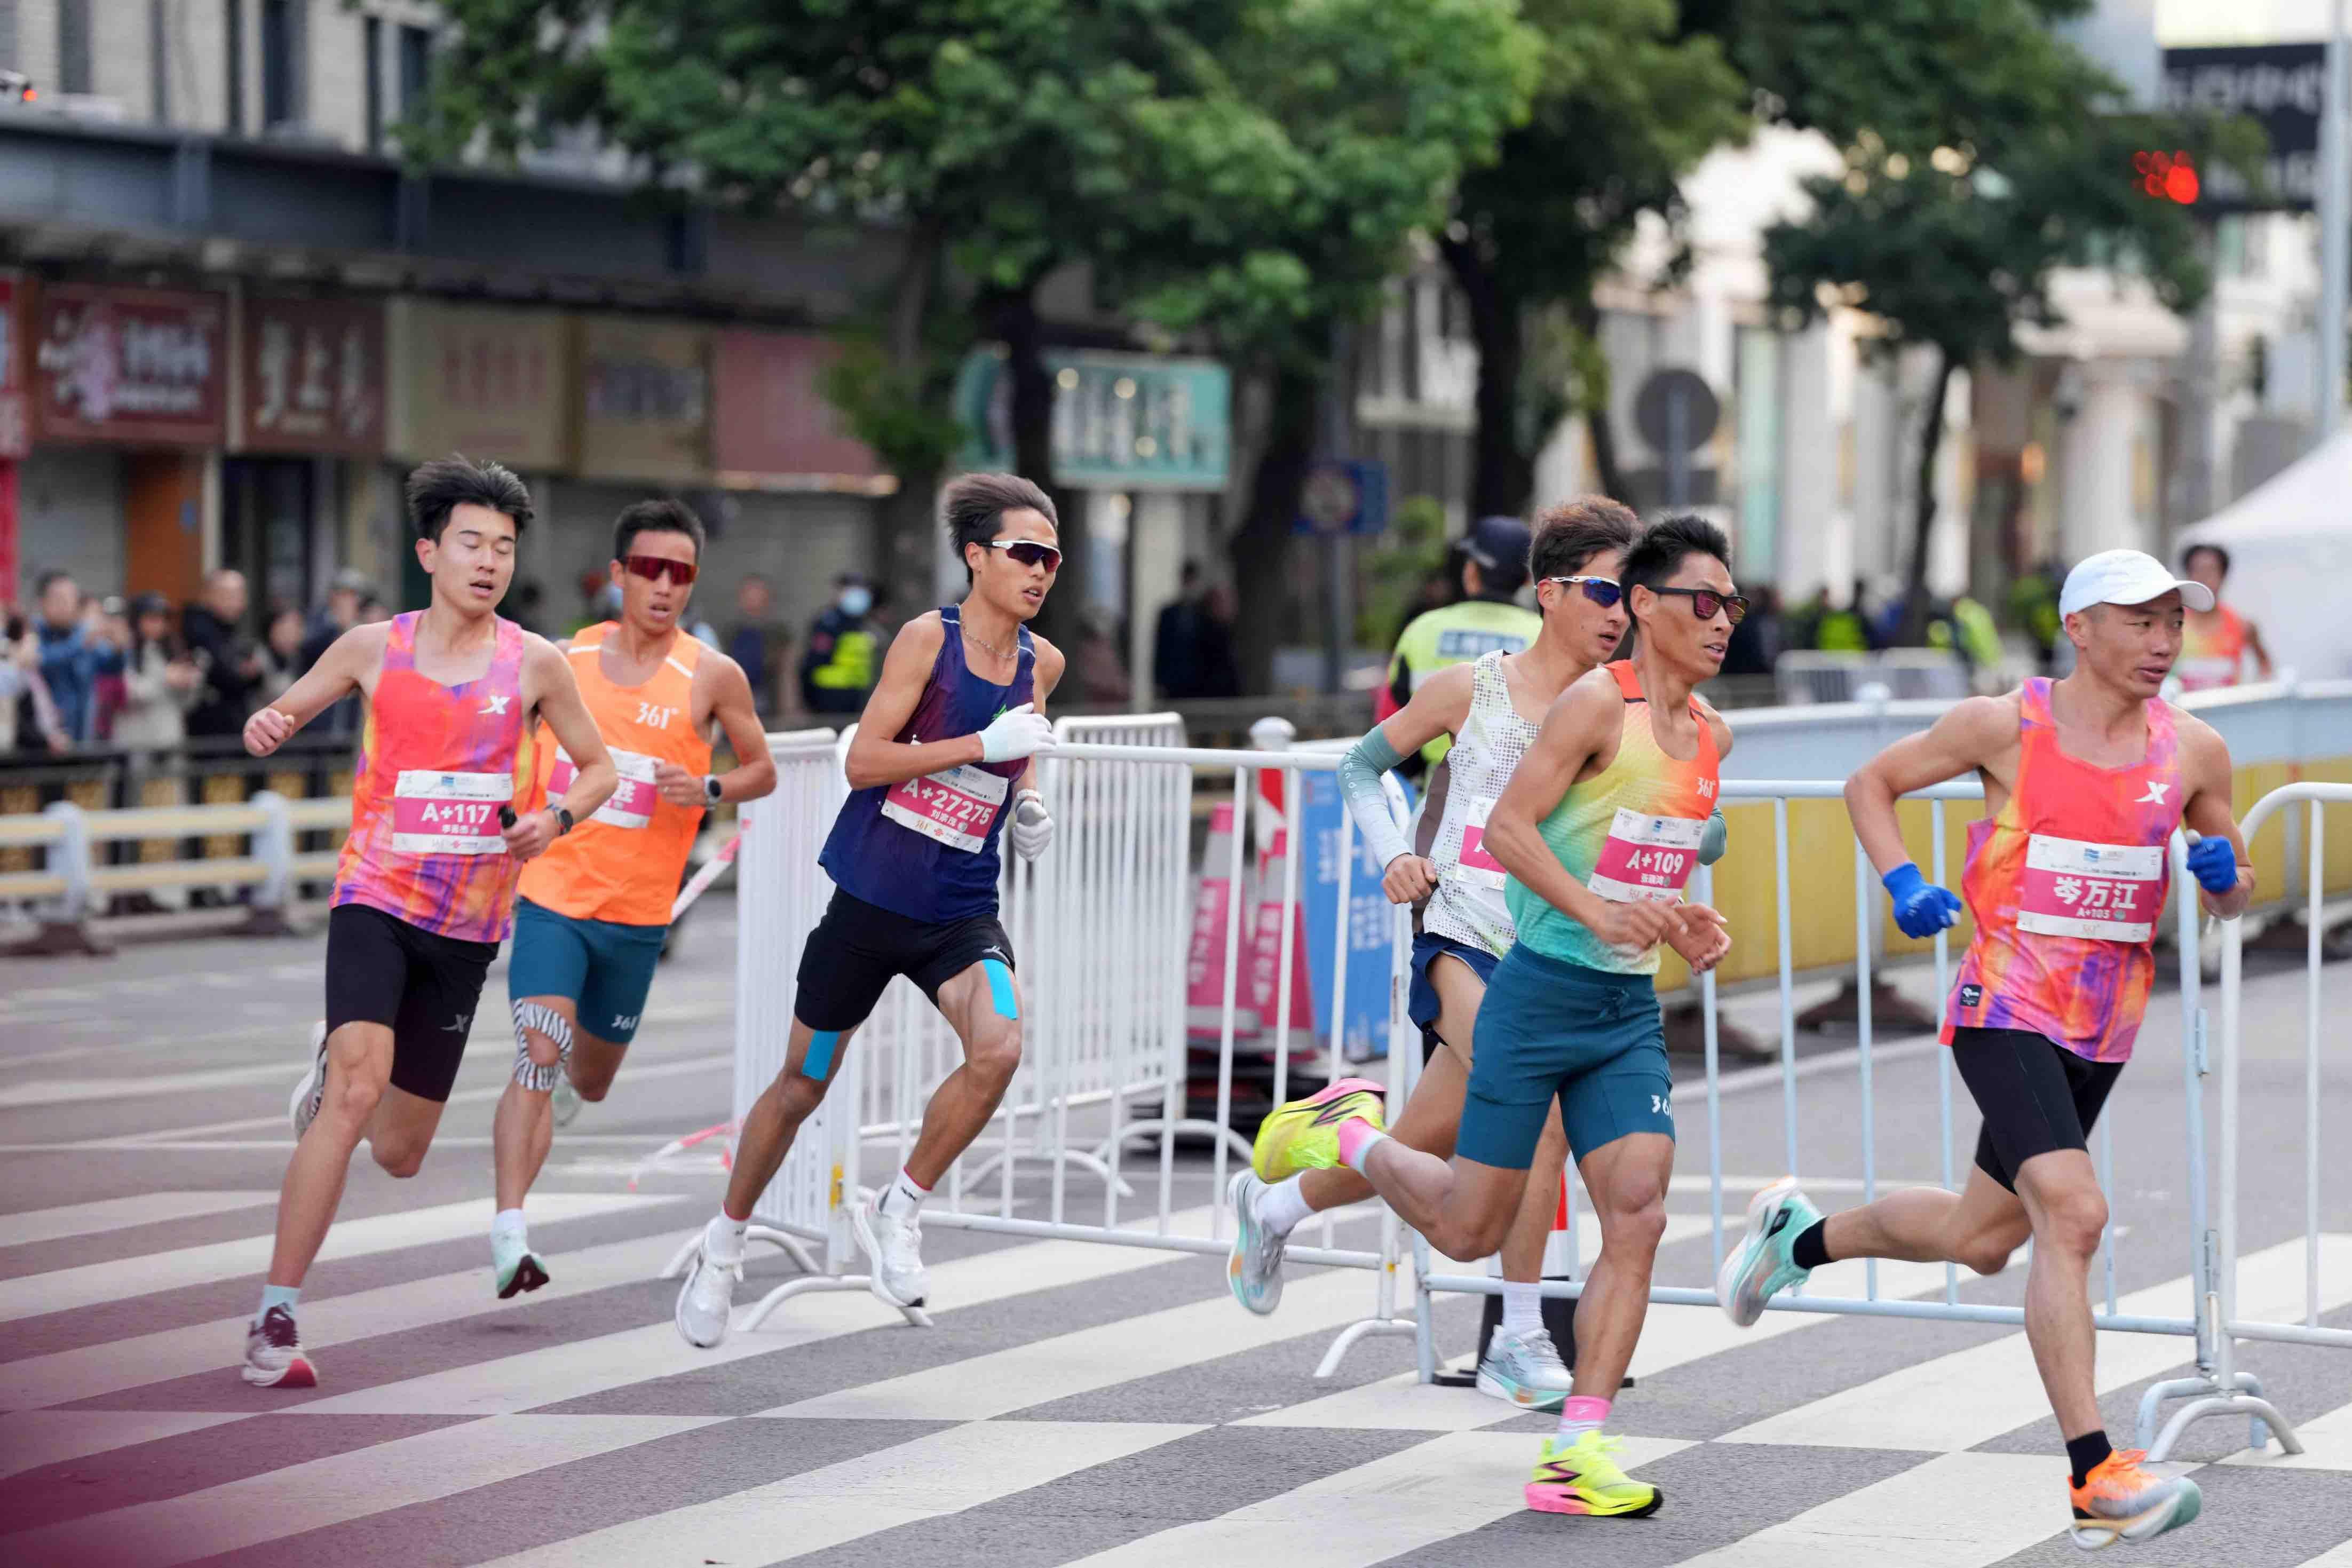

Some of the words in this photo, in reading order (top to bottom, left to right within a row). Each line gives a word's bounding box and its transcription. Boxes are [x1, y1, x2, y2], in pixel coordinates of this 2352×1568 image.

[421, 802, 492, 824] A+117
[901, 777, 993, 825] A+27275
[1625, 849, 1684, 874] A+109
[2053, 876, 2140, 909] 岑万江
